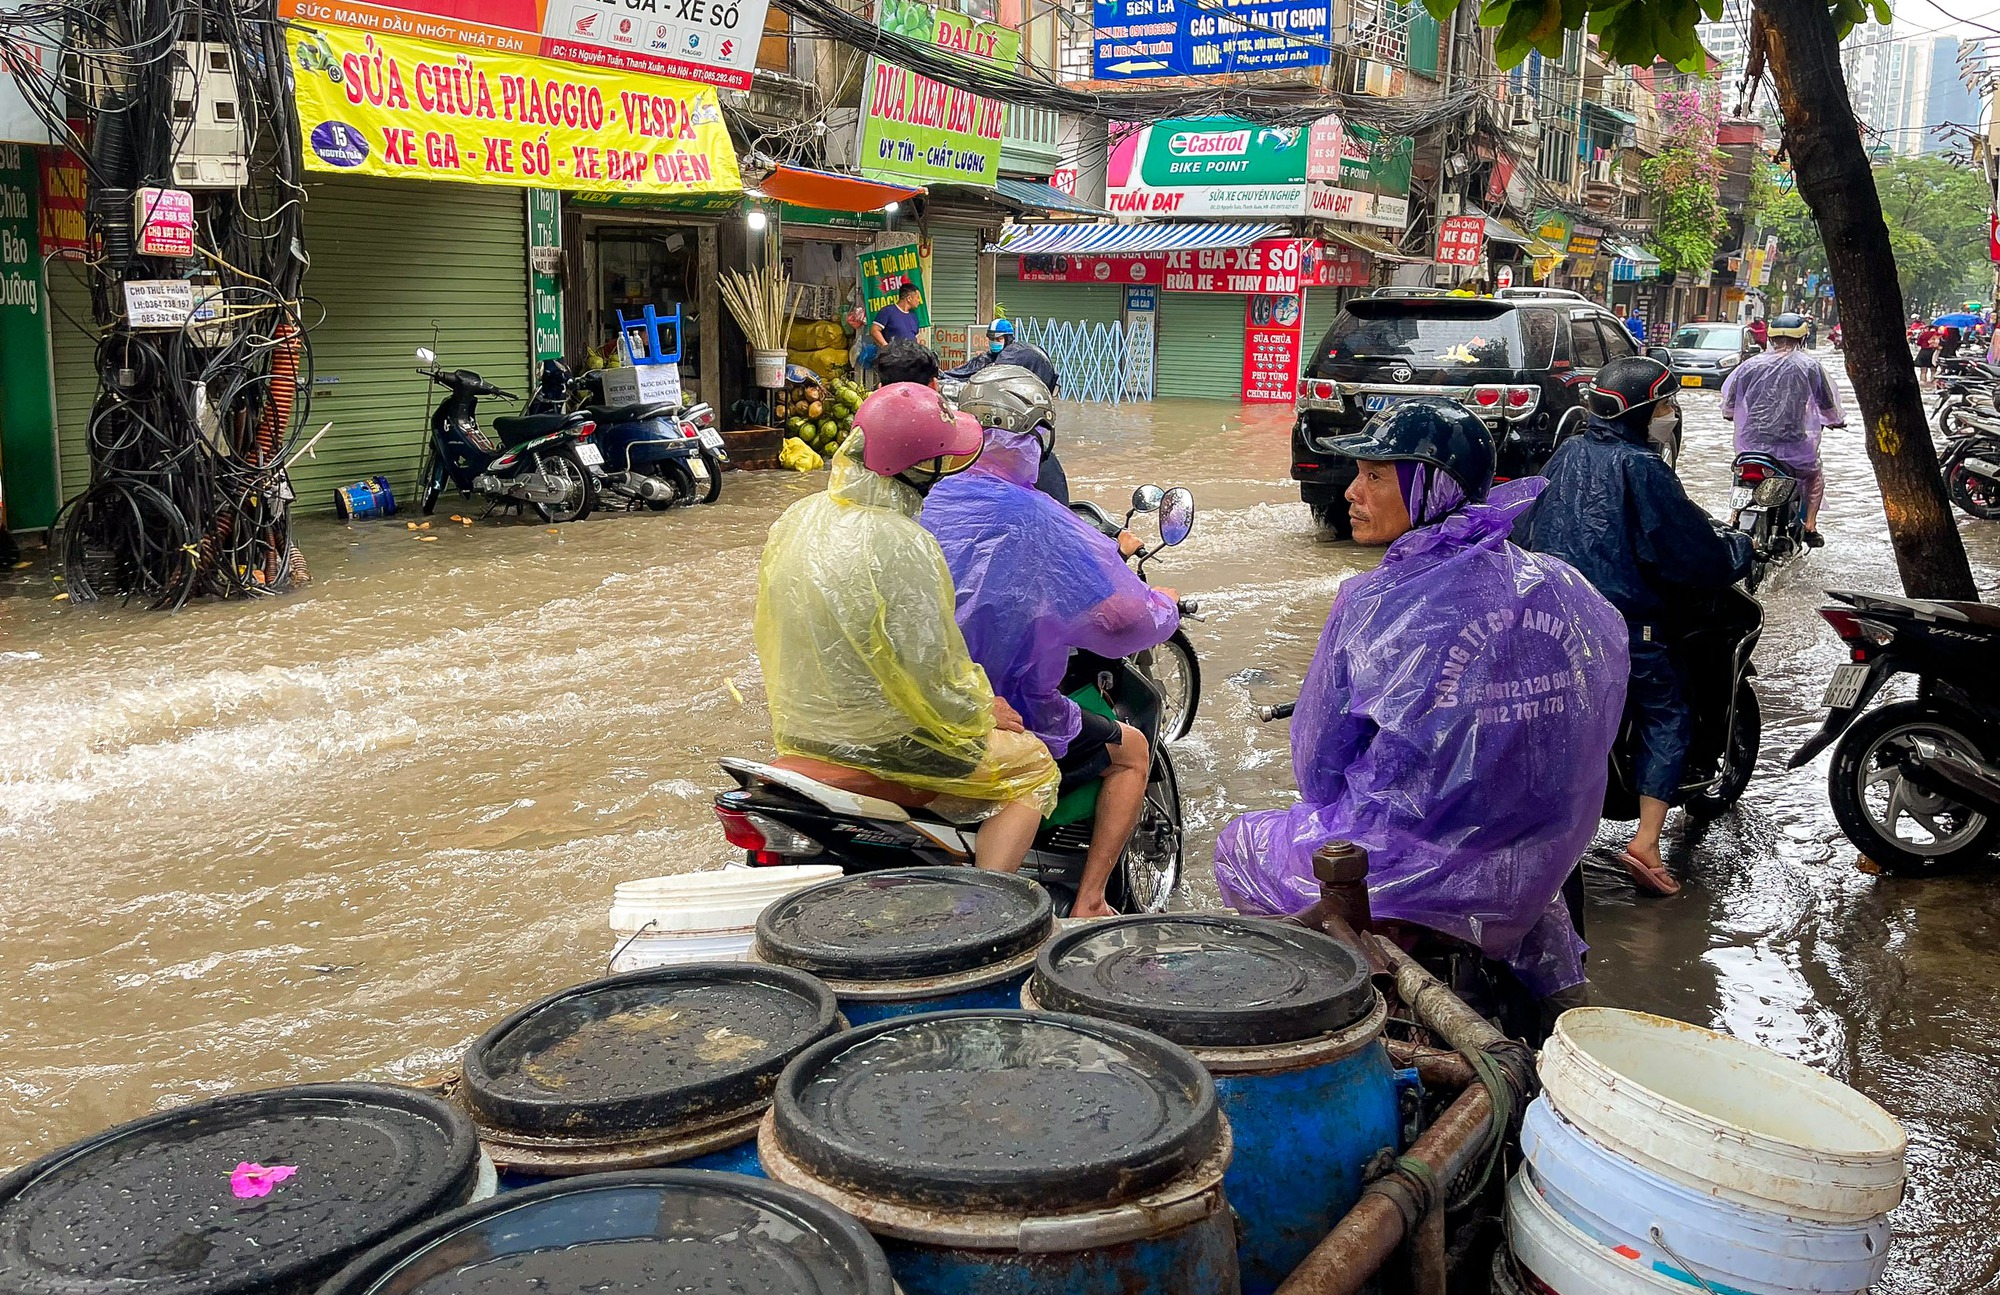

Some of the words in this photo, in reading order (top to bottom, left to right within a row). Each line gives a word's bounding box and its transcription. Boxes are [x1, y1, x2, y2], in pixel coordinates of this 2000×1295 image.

[676, 0, 704, 23] XE
[1190, 15, 1215, 36] CÁC
[1271, 9, 1288, 32] TỰ
[1290, 8, 1326, 30] CHỌN
[296, 2, 331, 19] SỨC
[335, 10, 378, 28] MẠNH
[383, 15, 413, 33] DẦU
[416, 22, 455, 39] NHỚT
[458, 28, 494, 46] NHẬT
[497, 35, 523, 50] BẢN
[651, 40, 668, 49] SYM
[938, 22, 972, 54] ĐẠI
[974, 31, 998, 57] LÝ
[1100, 44, 1112, 58] 21
[1149, 41, 1173, 55] TUÂN
[568, 47, 577, 57] 15
[578, 49, 606, 63] Nguyễn
[626, 57, 647, 69] Thanh
[667, 64, 677, 74] Hà
[1237, 54, 1260, 65] Phục
[1261, 55, 1274, 64] vụ
[1290, 50, 1308, 60] nhà
[343, 34, 410, 109] SỬA
[415, 54, 496, 119] CHỮA
[500, 75, 603, 131] PIAGGIO
[621, 91, 696, 140] VESPA
[332, 125, 347, 147] 15
[1188, 134, 1243, 153] Castrol
[1316, 132, 1325, 140] XE
[1327, 132, 1336, 141] GA
[382, 127, 418, 165] XE
[426, 131, 460, 169] GA
[483, 137, 514, 173] XE
[521, 131, 550, 176] SỐ
[572, 146, 602, 179] XE
[607, 150, 648, 188] ĐẠP
[654, 150, 712, 188] ĐIỆN
[880, 139, 894, 159] UY
[898, 137, 914, 163] TÍN
[927, 140, 953, 168] CHẤT
[954, 149, 985, 175] LƯỢNG
[1314, 149, 1324, 157] XE
[1325, 146, 1335, 158] SỐ
[1169, 161, 1201, 173] BIKE
[1206, 160, 1249, 173] POINT
[1327, 165, 1336, 174] XE
[1350, 167, 1370, 180] POINT
[535, 188, 555, 218] Thay
[1109, 188, 1149, 211] TUẤN
[1152, 193, 1184, 214] ĐẠT
[1225, 191, 1237, 201] XE
[1237, 189, 1269, 201] CHUYÊN
[1269, 188, 1301, 203] NGHIỆP
[1335, 195, 1353, 217] ĐẠT
[2, 225, 28, 264] Bảo
[1443, 230, 1459, 242] XE
[1460, 231, 1478, 244] GA
[1166, 250, 1192, 269] XE
[1268, 241, 1300, 271] SỐ
[1440, 247, 1455, 260] XE
[1457, 246, 1478, 261] SỐ
[863, 254, 880, 277] CHÈ
[130, 287, 145, 296] CHO
[1166, 270, 1194, 289] RỬA
[1197, 274, 1214, 290] XE
[1227, 275, 1262, 291] THAY
[1266, 271, 1296, 292] DẦU
[536, 288, 556, 320] Tùng
[536, 327, 560, 354] Chính
[936, 329, 966, 343] Cháo
[1253, 353, 1274, 362] THAY
[1252, 371, 1267, 382] PHỤ
[1268, 370, 1289, 381] TÙNG
[1247, 387, 1269, 399] CHÍNH
[1458, 620, 1487, 648] TY
[1523, 608, 1564, 640] ANH
[1524, 675, 1551, 695] 120
